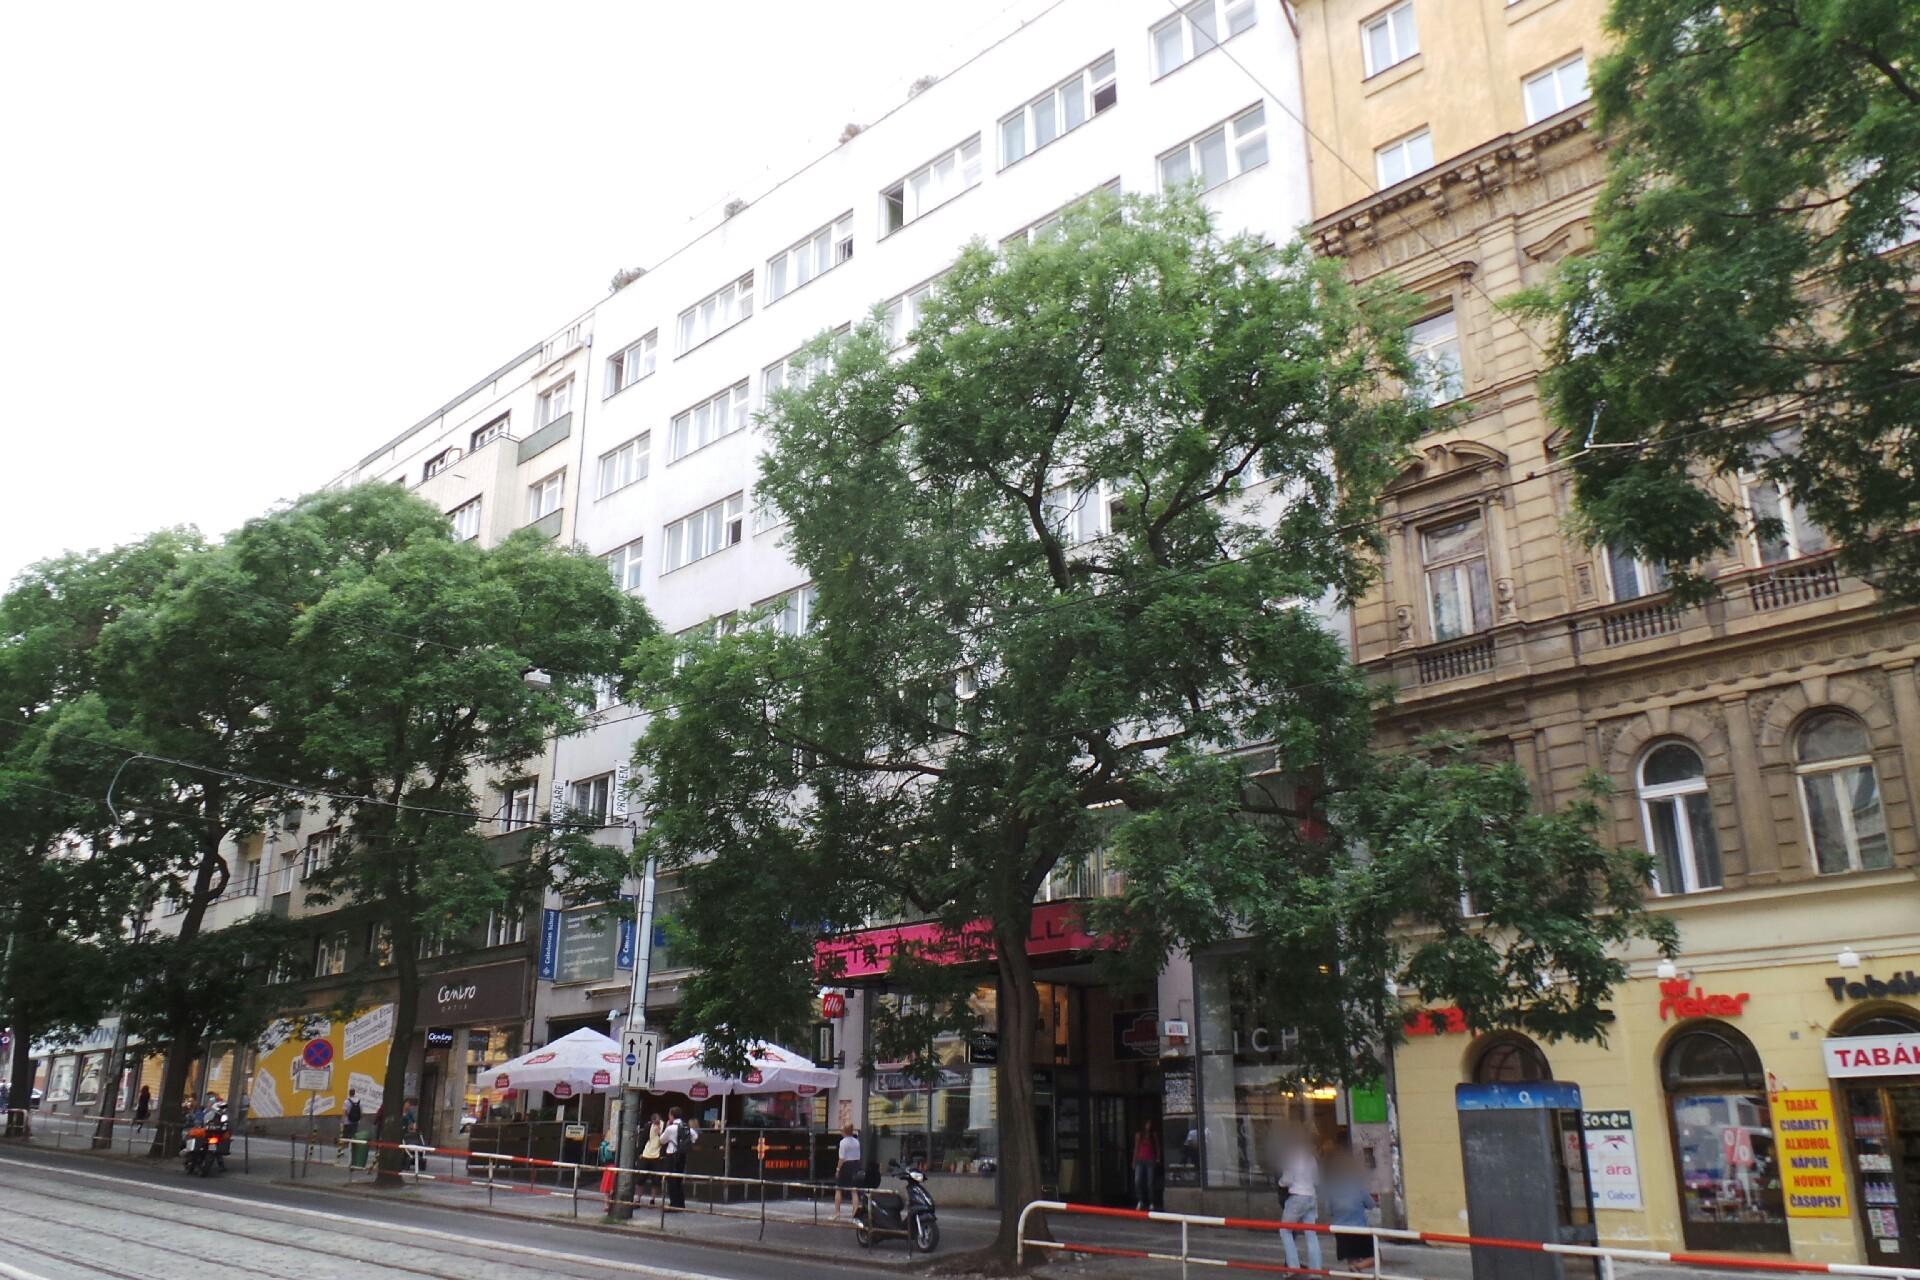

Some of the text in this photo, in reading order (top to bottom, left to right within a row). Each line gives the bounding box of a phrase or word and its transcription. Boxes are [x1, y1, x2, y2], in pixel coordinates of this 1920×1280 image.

[438, 985, 476, 1003] Centro
[428, 1033, 453, 1041] Centro
[1780, 1119, 1829, 1131] CIGARETY
[1785, 1137, 1831, 1150] ALKOHOL
[1606, 1164, 1632, 1175] ara
[1793, 1174, 1832, 1188] NOVINY
[1789, 1193, 1841, 1208] ČASOPISY
